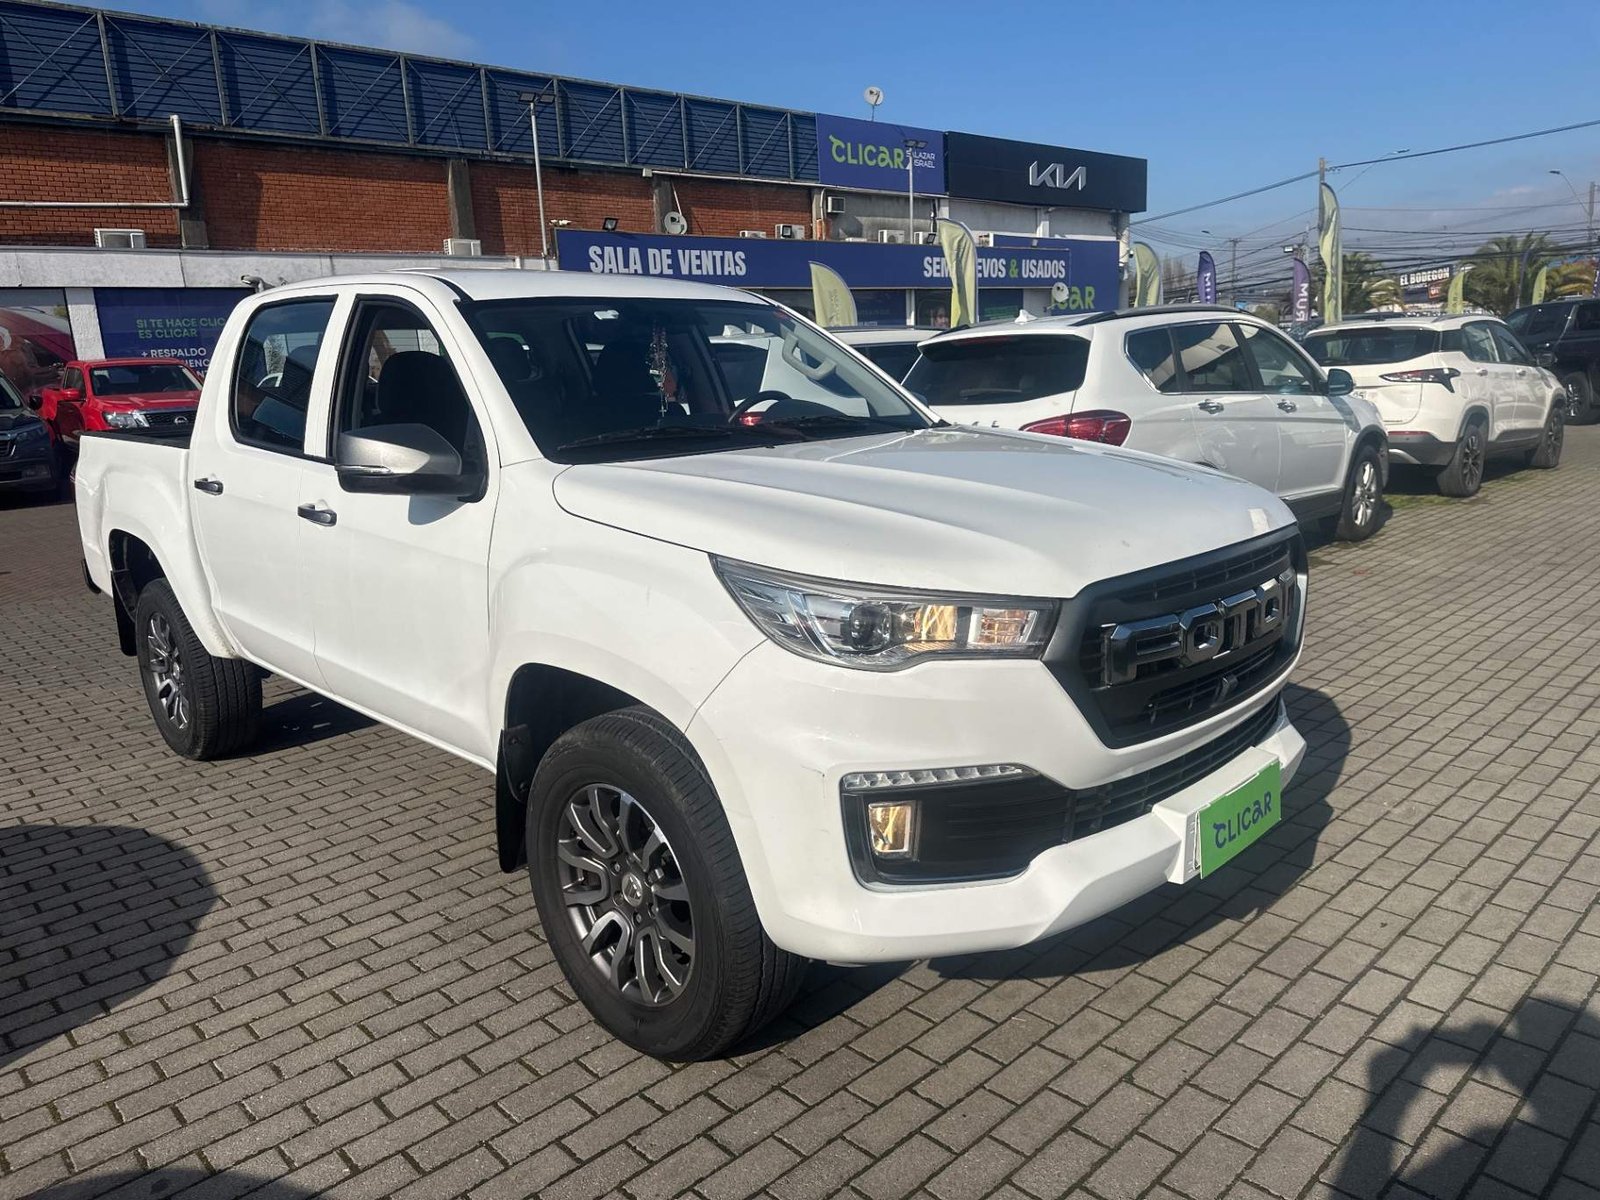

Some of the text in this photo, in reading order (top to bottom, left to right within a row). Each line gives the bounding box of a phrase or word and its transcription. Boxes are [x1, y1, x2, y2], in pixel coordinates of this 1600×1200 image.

[1029, 160, 1087, 191] KIA
[588, 245, 747, 277] SALA DE VENTAS
[1009, 259, 1019, 278] &
[1021, 259, 1066, 279] USADOS
[1400, 274, 1409, 286] EL
[136, 319, 148, 329] SI
[149, 318, 164, 328] TE
[166, 318, 197, 328] HACE
[138, 328, 198, 339] ES CLICAR
[150, 347, 207, 358] RESPALDO
